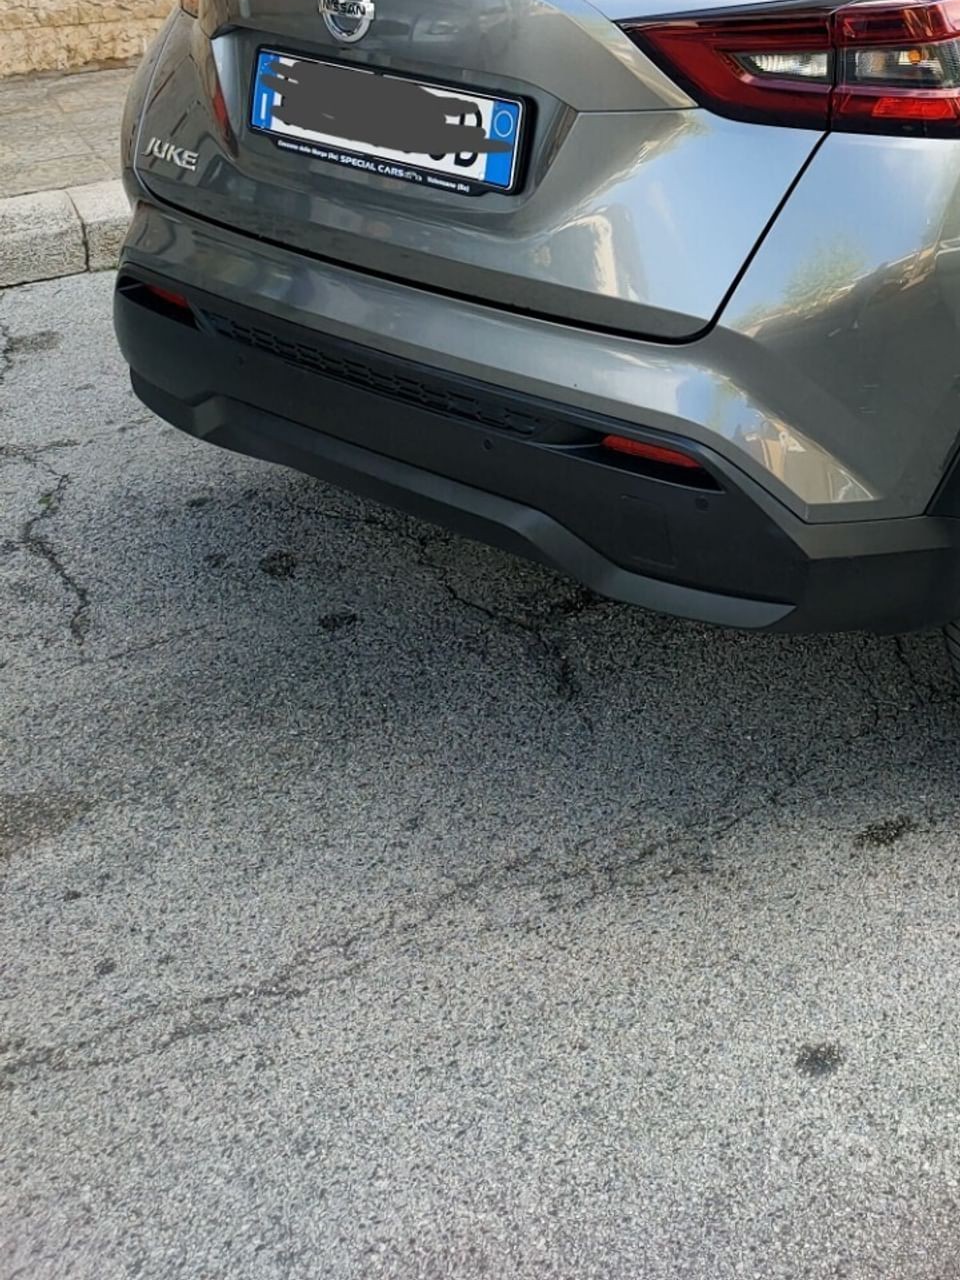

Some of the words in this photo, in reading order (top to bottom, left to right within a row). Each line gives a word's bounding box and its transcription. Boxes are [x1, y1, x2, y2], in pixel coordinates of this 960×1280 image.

[143, 137, 199, 171] JUKE
[339, 155, 377, 172] SPECIAL
[378, 164, 404, 178] CARS
